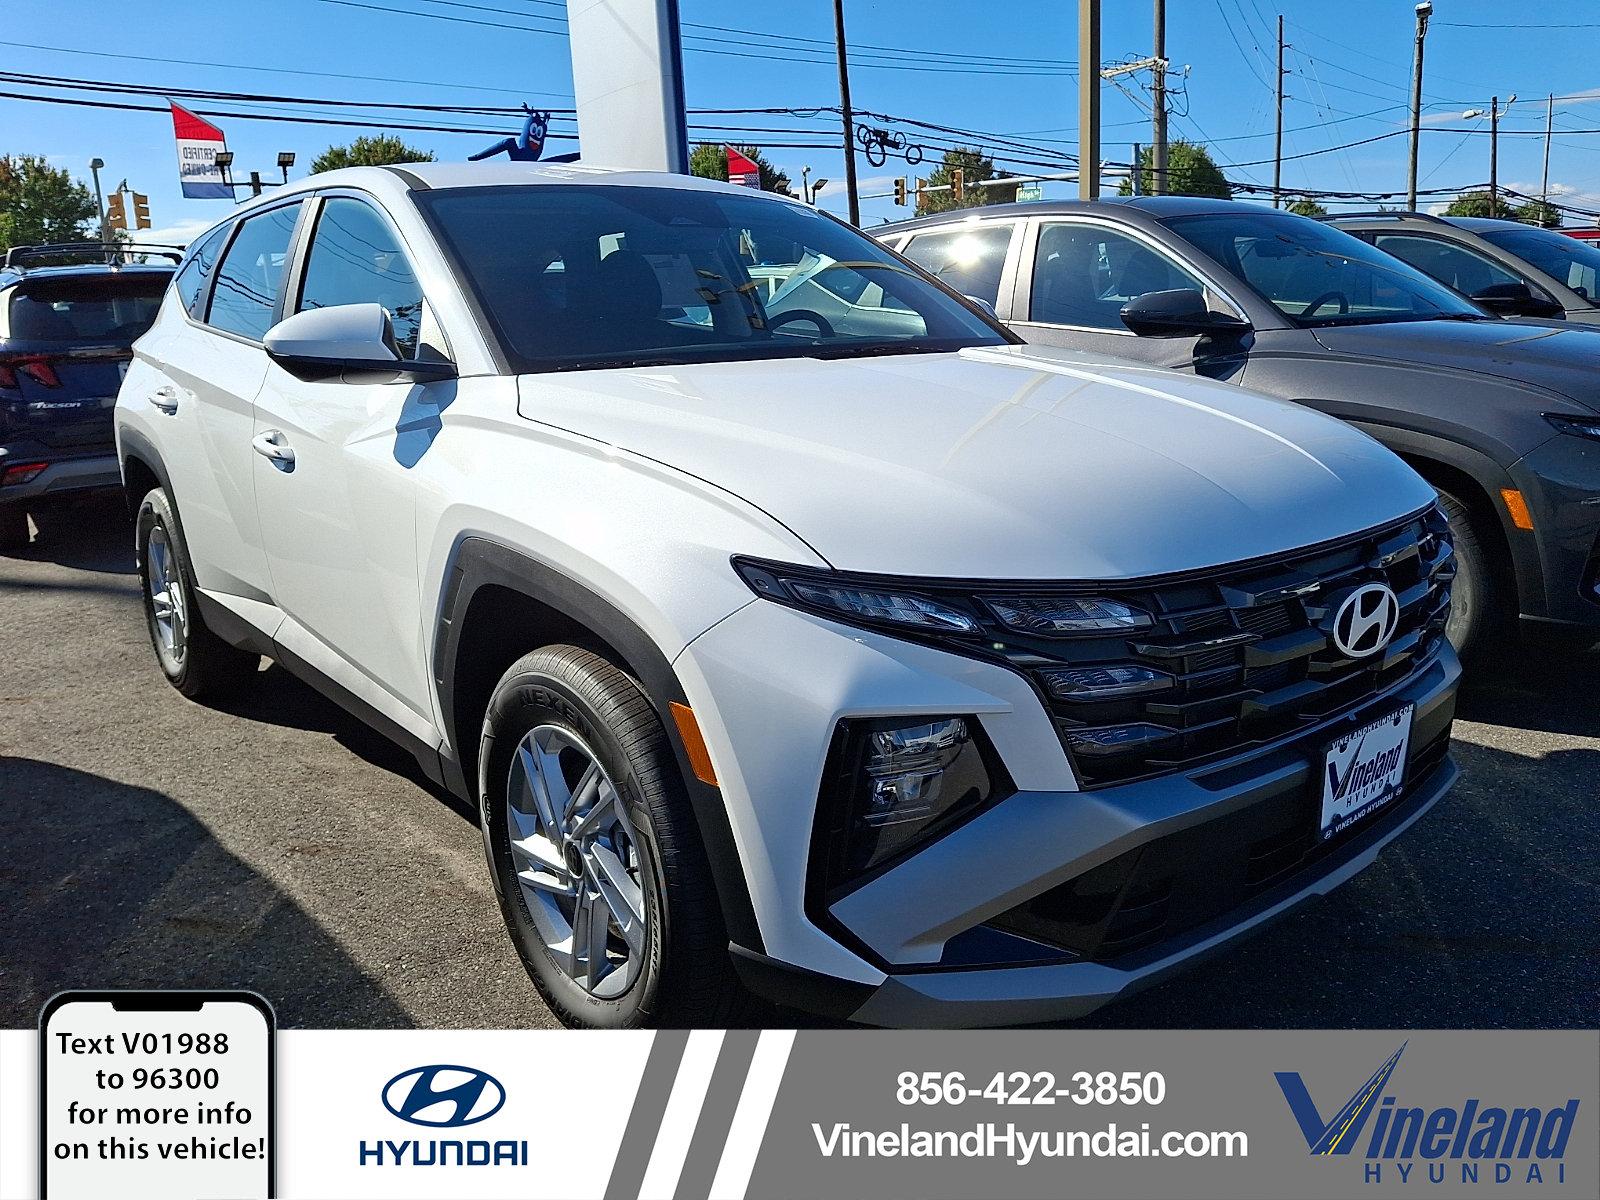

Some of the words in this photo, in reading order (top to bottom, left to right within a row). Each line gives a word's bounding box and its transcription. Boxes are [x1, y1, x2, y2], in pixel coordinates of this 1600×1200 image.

[1328, 734, 1404, 802] Vineland
[1346, 771, 1396, 808] HYUNDAI
[1335, 808, 1366, 833] VINELAND
[1367, 792, 1394, 814] HYUNDAI
